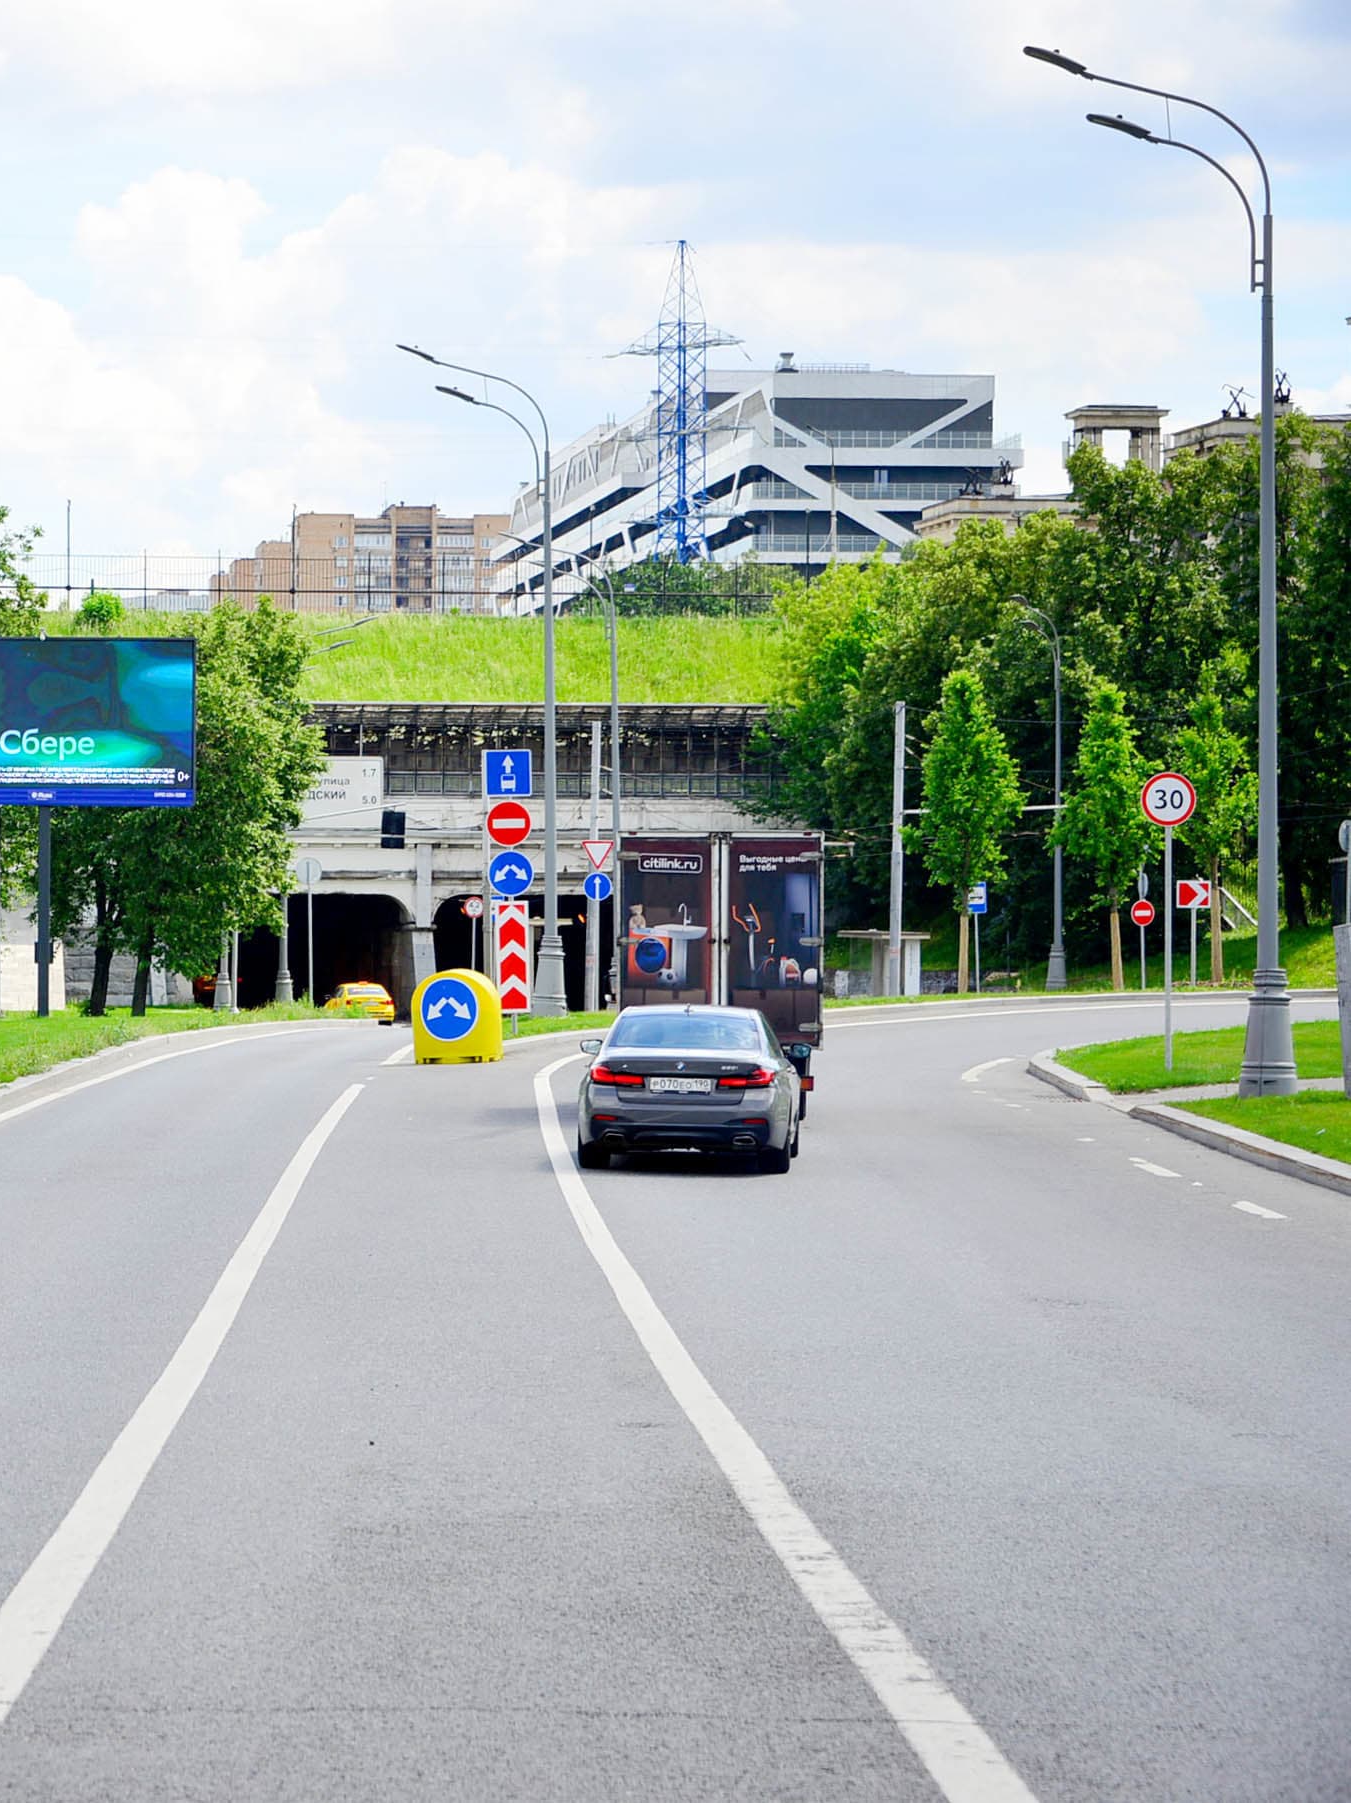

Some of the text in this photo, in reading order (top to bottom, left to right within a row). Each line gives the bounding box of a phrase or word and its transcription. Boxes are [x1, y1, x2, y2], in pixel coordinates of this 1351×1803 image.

[0, 728, 96, 760] Сбере
[1154, 790, 1184, 809] 30
[643, 857, 698, 870] citilink.ru
[739, 854, 783, 864] Выгодные
[739, 864, 755, 872] для
